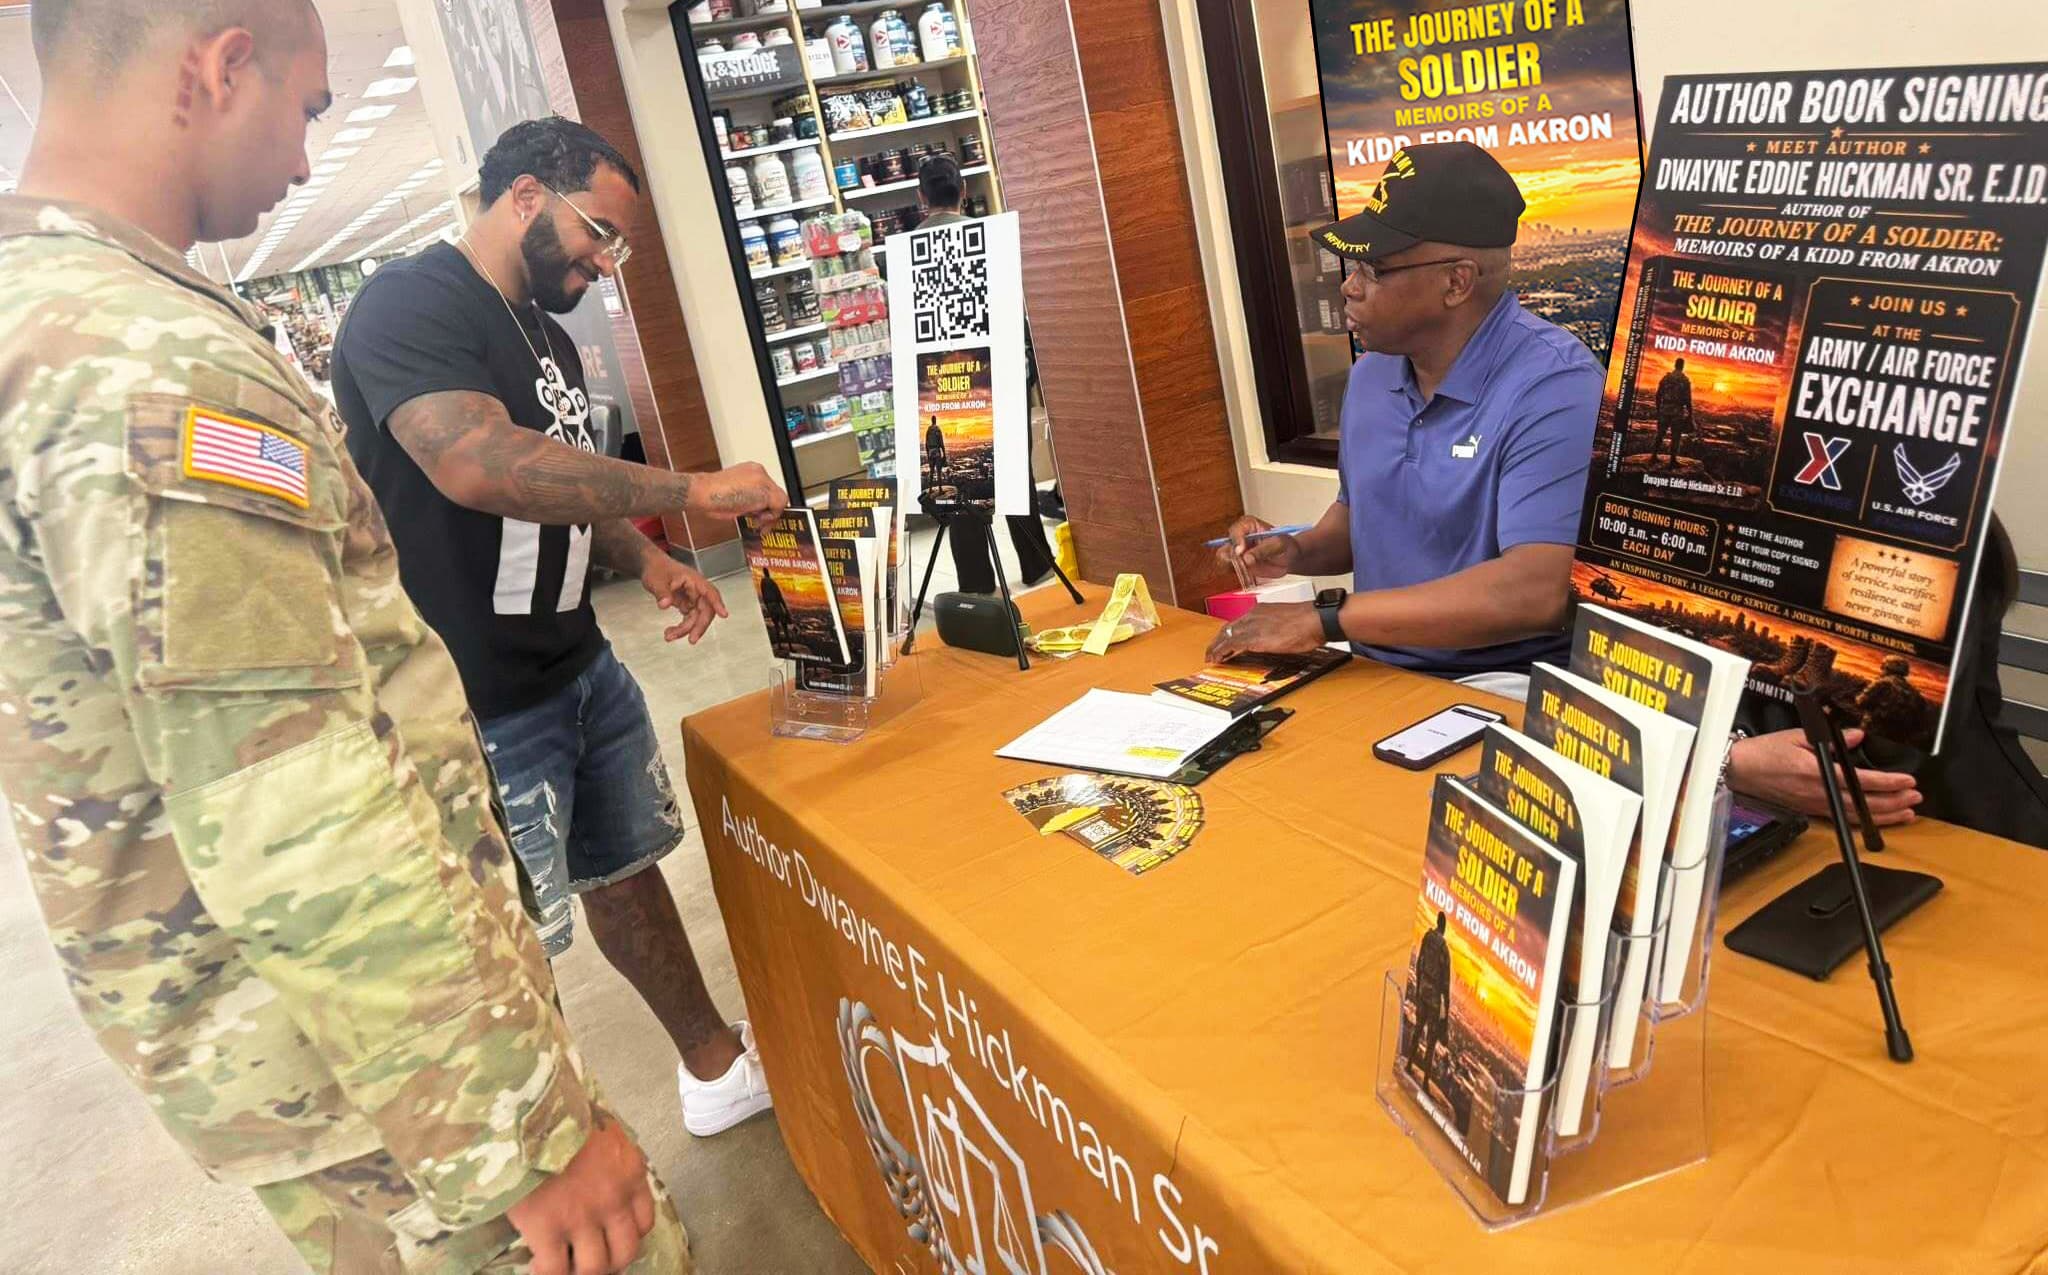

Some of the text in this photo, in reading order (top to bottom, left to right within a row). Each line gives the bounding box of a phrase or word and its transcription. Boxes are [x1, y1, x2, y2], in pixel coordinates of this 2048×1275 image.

[1350, 0, 1585, 55] THE JOURNEY OF A
[1398, 42, 1541, 101] SOLDIER
[1395, 93, 1553, 127] MEMOIRS OF A
[1669, 73, 2048, 124] AUTHOR BOOK SIGNING
[1507, 112, 1613, 147] AKRON
[1765, 140, 1908, 156] MEET AUTHOR
[1391, 150, 1416, 179] RMY
[1655, 158, 1743, 194] DWAYNE
[1744, 160, 1813, 196] EDDIE
[1814, 161, 1933, 200] HICKMAN
[1934, 163, 1974, 202] SR.
[1781, 203, 1871, 218] AUTHOR OF
[1322, 231, 1370, 253] INFANTRY
[1673, 214, 2005, 252] THE JOURNEY OF A SOLDIER:
[1672, 238, 2002, 276] MEMOIRS OF A KIDD FROM AKRON
[1672, 270, 1783, 301] THE JOURNEY OF A
[1686, 294, 1757, 326] SOLDIER
[1868, 295, 1946, 316] JOIN US
[1681, 323, 1755, 342] MEMOIRS OF A
[1872, 325, 1922, 341] AT THE
[1654, 335, 1775, 364] KIDD FROM AKRON
[1805, 336, 1997, 389] ARMY / AIR FORCE
[937, 375, 970, 393] SOLDIER
[961, 400, 986, 410] AKRON
[1794, 371, 1988, 447] EXCHANGE
[1642, 473, 1669, 487] Dwayne
[1670, 477, 1687, 489] Eddie
[1688, 480, 1716, 493] Hickman
[1604, 501, 1710, 537] BOOK SIGNING HOURS:
[1871, 501, 1895, 514] U.S.
[1896, 505, 1916, 517] AIR
[1917, 511, 1959, 526] FORCE
[1599, 516, 1627, 535] 10:00
[1627, 526, 1648, 541] a.m.
[1661, 532, 1686, 550] 6:00
[1686, 541, 1707, 556] p.m.
[1622, 539, 1676, 562] EACH DAY
[1738, 526, 1804, 549] MEET THE AUTHOR
[1733, 555, 1781, 575] TAKE PHOTOS
[1735, 540, 1820, 569] GET YOUR COPY SIGNED
[1729, 569, 1775, 588] BE INSPIRED
[1841, 569, 1851, 580] of
[1851, 573, 1890, 590] service,
[1861, 560, 1907, 579] powerful
[1908, 571, 1935, 586] story
[1609, 559, 1620, 569] AN
[1621, 562, 1661, 580] INSPIRING
[1690, 582, 1697, 591] A
[1698, 584, 1729, 600] LEGACY
[1730, 593, 1743, 602] OF
[1783, 608, 1790, 618] A
[1791, 609, 1832, 630] JOURNEY
[1834, 621, 1869, 639] WORTH
[1845, 600, 1871, 613] never
[1872, 607, 1906, 625] giving
[1901, 601, 1923, 613] and
[1588, 629, 1694, 699] THE JOURNEY OF A
[1601, 665, 1668, 714] SOLDIER
[1742, 677, 1795, 703] COMMITM
[1541, 689, 1631, 765] THE JOURNEY OF A
[1554, 727, 1612, 780] SOLDIER
[1494, 750, 1575, 829] THE JOURNEY OF A
[1444, 802, 1544, 898] THE JOURNEY OF A
[1456, 845, 1520, 921] SOLDIER
[1450, 875, 1516, 943] MEMOIRS OF A
[1425, 879, 1537, 990] KIDD FROM AKRON
[721, 795, 1219, 1275] Author Dwayne E Hickman Sr
